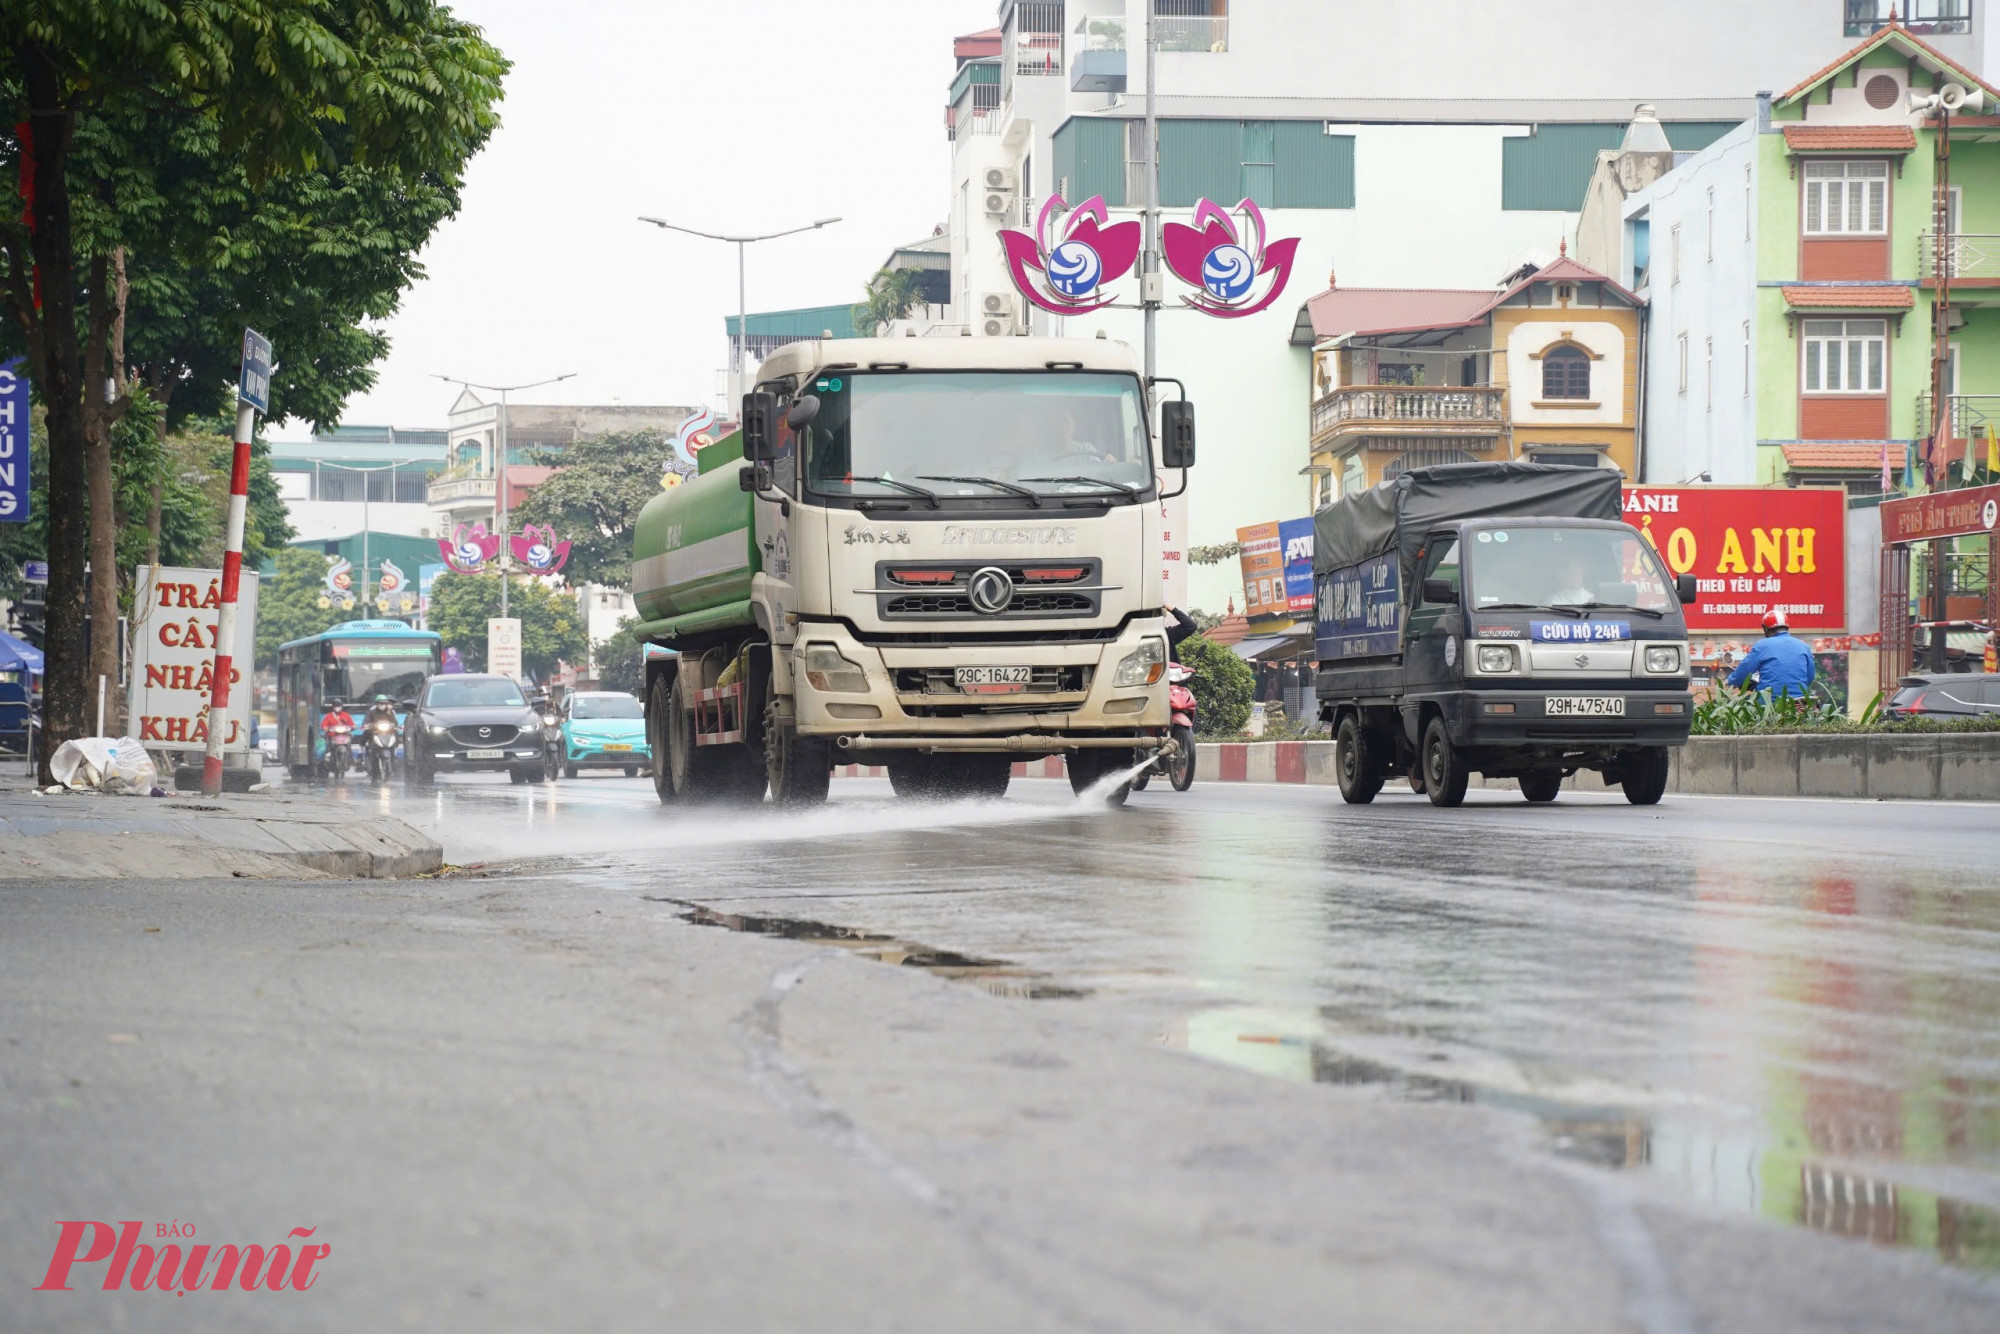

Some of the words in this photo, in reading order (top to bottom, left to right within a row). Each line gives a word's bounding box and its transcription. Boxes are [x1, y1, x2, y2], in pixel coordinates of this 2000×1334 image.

[1716, 527, 1817, 574] ANH
[156, 578, 221, 609] TRÁ
[1696, 579, 1726, 593] THEO
[1730, 576, 1753, 593] YÊU
[1542, 622, 1570, 639] CỨU
[1573, 622, 1592, 642] HỘ
[1595, 624, 1620, 639] 24H
[144, 659, 240, 697] NHẬP
[958, 668, 1029, 683] 29C-164.22
[1548, 699, 1622, 714] 29H-475.40
